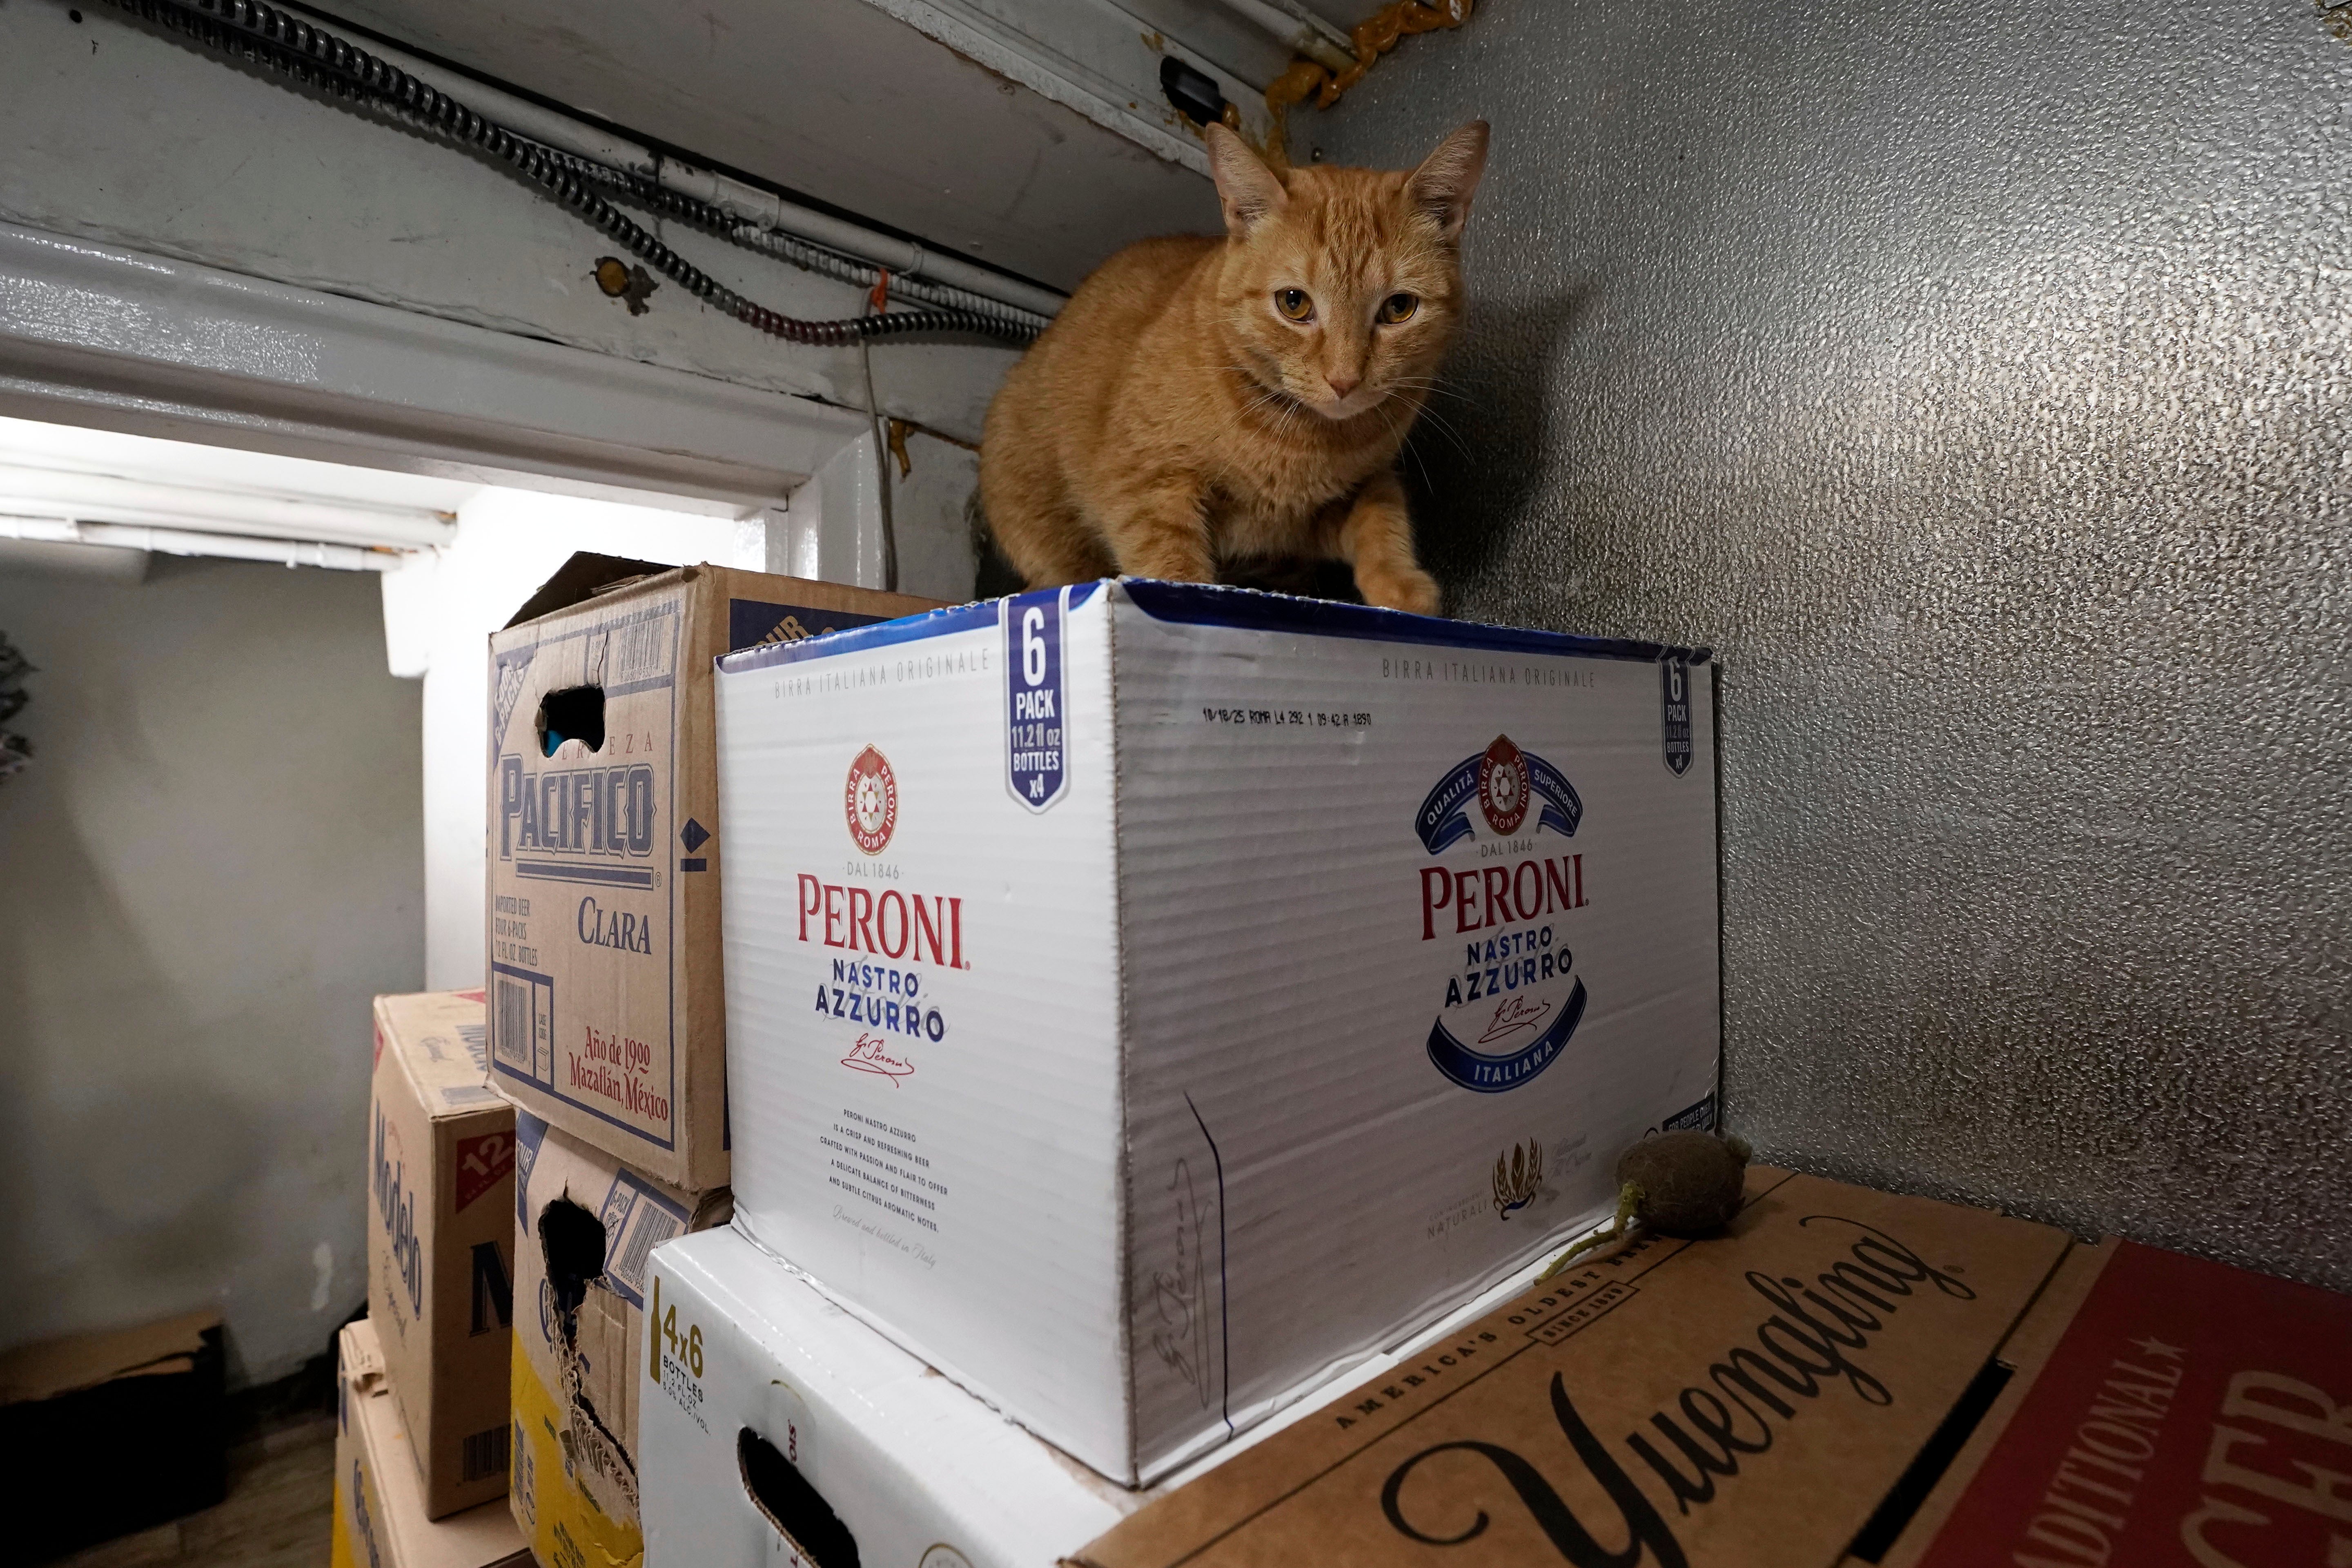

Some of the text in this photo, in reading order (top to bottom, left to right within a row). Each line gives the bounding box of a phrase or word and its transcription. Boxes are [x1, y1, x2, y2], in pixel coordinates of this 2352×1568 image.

[1022, 606, 1045, 686] 6
[775, 648, 989, 699] BIRRA ITALIANA ORIGINALE
[1382, 659, 1595, 688] BIRRA ITALIANA ORIGINALE
[1668, 656, 1681, 702] 6
[1016, 690, 1055, 720] PACK
[1668, 704, 1686, 722] PACK
[549, 731, 653, 761] EREZA
[1047, 728, 1060, 747] oz
[1667, 742, 1689, 753] BOTTLES
[1013, 751, 1060, 772] BOTTLES
[1484, 757, 1493, 809] BIRRA
[1514, 755, 1528, 807] PERONI
[1676, 754, 1682, 769] x4
[500, 753, 657, 860] PACIFICO
[848, 768, 860, 824] BIRRA
[881, 765, 895, 828] PERONI
[1029, 773, 1045, 798] x4
[1534, 769, 1578, 817] SUPERIORE
[858, 830, 886, 848] ROMA
[1492, 812, 1520, 829] ROMA
[847, 861, 899, 880] DAL 1846
[1481, 839, 1533, 858] DAL 1846
[496, 895, 530, 916] IMPORTED BEER
[1420, 854, 1584, 940] PERONI
[496, 918, 526, 940] FOUR 6-PACKS
[578, 896, 651, 955] CLARA
[797, 873, 963, 970] PERONI
[519, 945, 537, 967] BOTTLES
[1468, 926, 1551, 965] NASTRO
[833, 958, 919, 998] NASTRO
[1445, 948, 1572, 1008] AZZURRO
[815, 985, 944, 1043] AZZURRO
[584, 1026, 650, 1074] Año de 1900
[1474, 1040, 1553, 1082] ITALIANA
[624, 1073, 668, 1121] México
[1680, 1109, 1699, 1129] PEOPLE
[843, 1109, 916, 1142] PERONI NASTRO AZZURRO
[462, 1135, 514, 1176] 12
[820, 1136, 948, 1196] CRAFTED WITH PASSION AND FLAIR TO OFFER
[846, 1128, 862, 1140] CRISP
[864, 1135, 875, 1146] AND
[878, 1141, 912, 1161] REFRESHING
[915, 1156, 930, 1168] BEER
[829, 1176, 939, 1233] AND SUBTLE CITRUS AROMATIC NOTES.
[836, 1161, 861, 1178] DELICATE
[863, 1172, 889, 1190] BALANCE
[891, 1185, 898, 1193] OF
[901, 1189, 935, 1211] BITTERNESS
[833, 1205, 937, 1271] Brewed and bottled in Italy
[664, 1304, 703, 1378] 4x6
[1336, 1234, 1663, 1430] AMERICA'S OLDEST BREW
[1542, 1310, 1590, 1338] SINCE
[664, 1355, 703, 1403] BOTTLES
[1380, 1215, 1978, 1568] Yuengling
